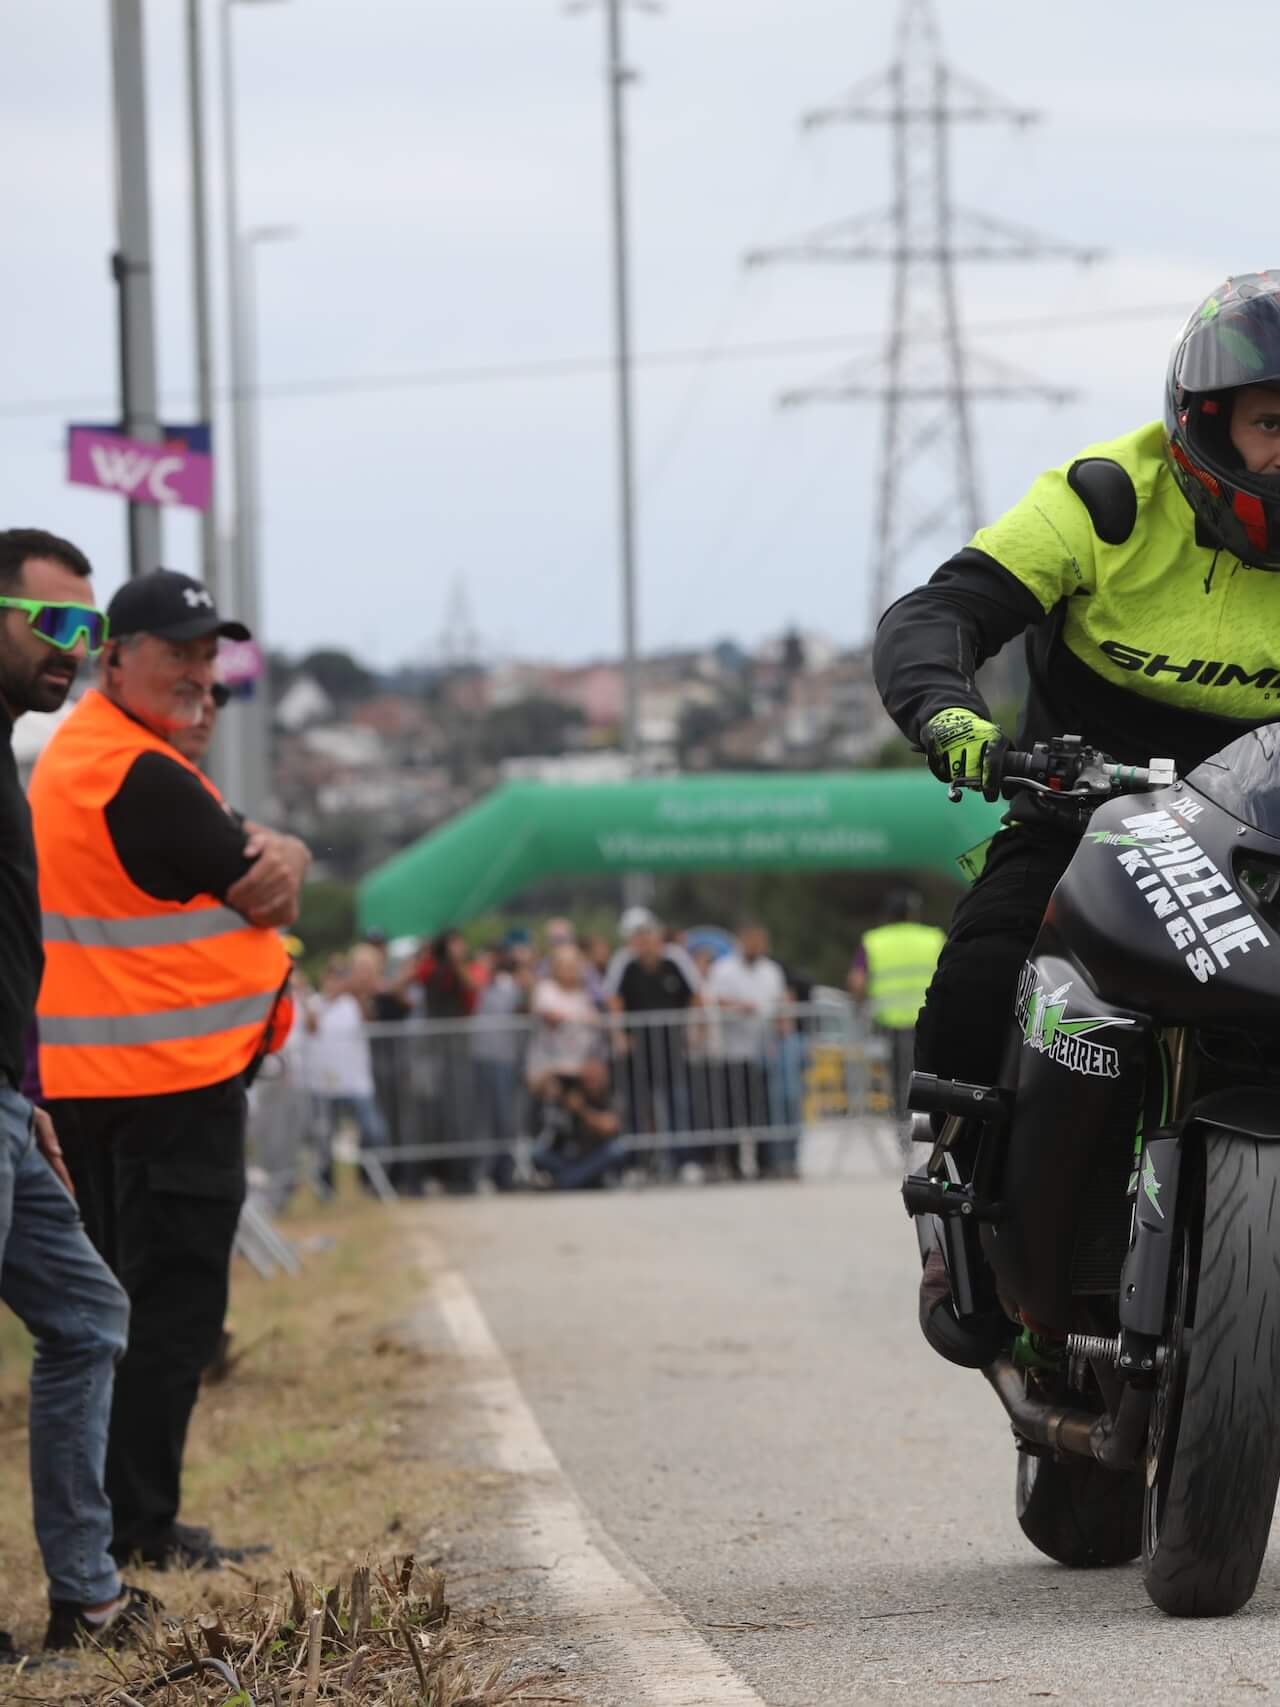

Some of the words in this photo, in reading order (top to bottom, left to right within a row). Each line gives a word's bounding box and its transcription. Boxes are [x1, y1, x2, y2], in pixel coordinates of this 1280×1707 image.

[89, 445, 185, 502] WC
[1116, 849, 1217, 984] KINGS
[1120, 809, 1271, 969] WHEELIE
[1048, 1026, 1121, 1078] FERRER
